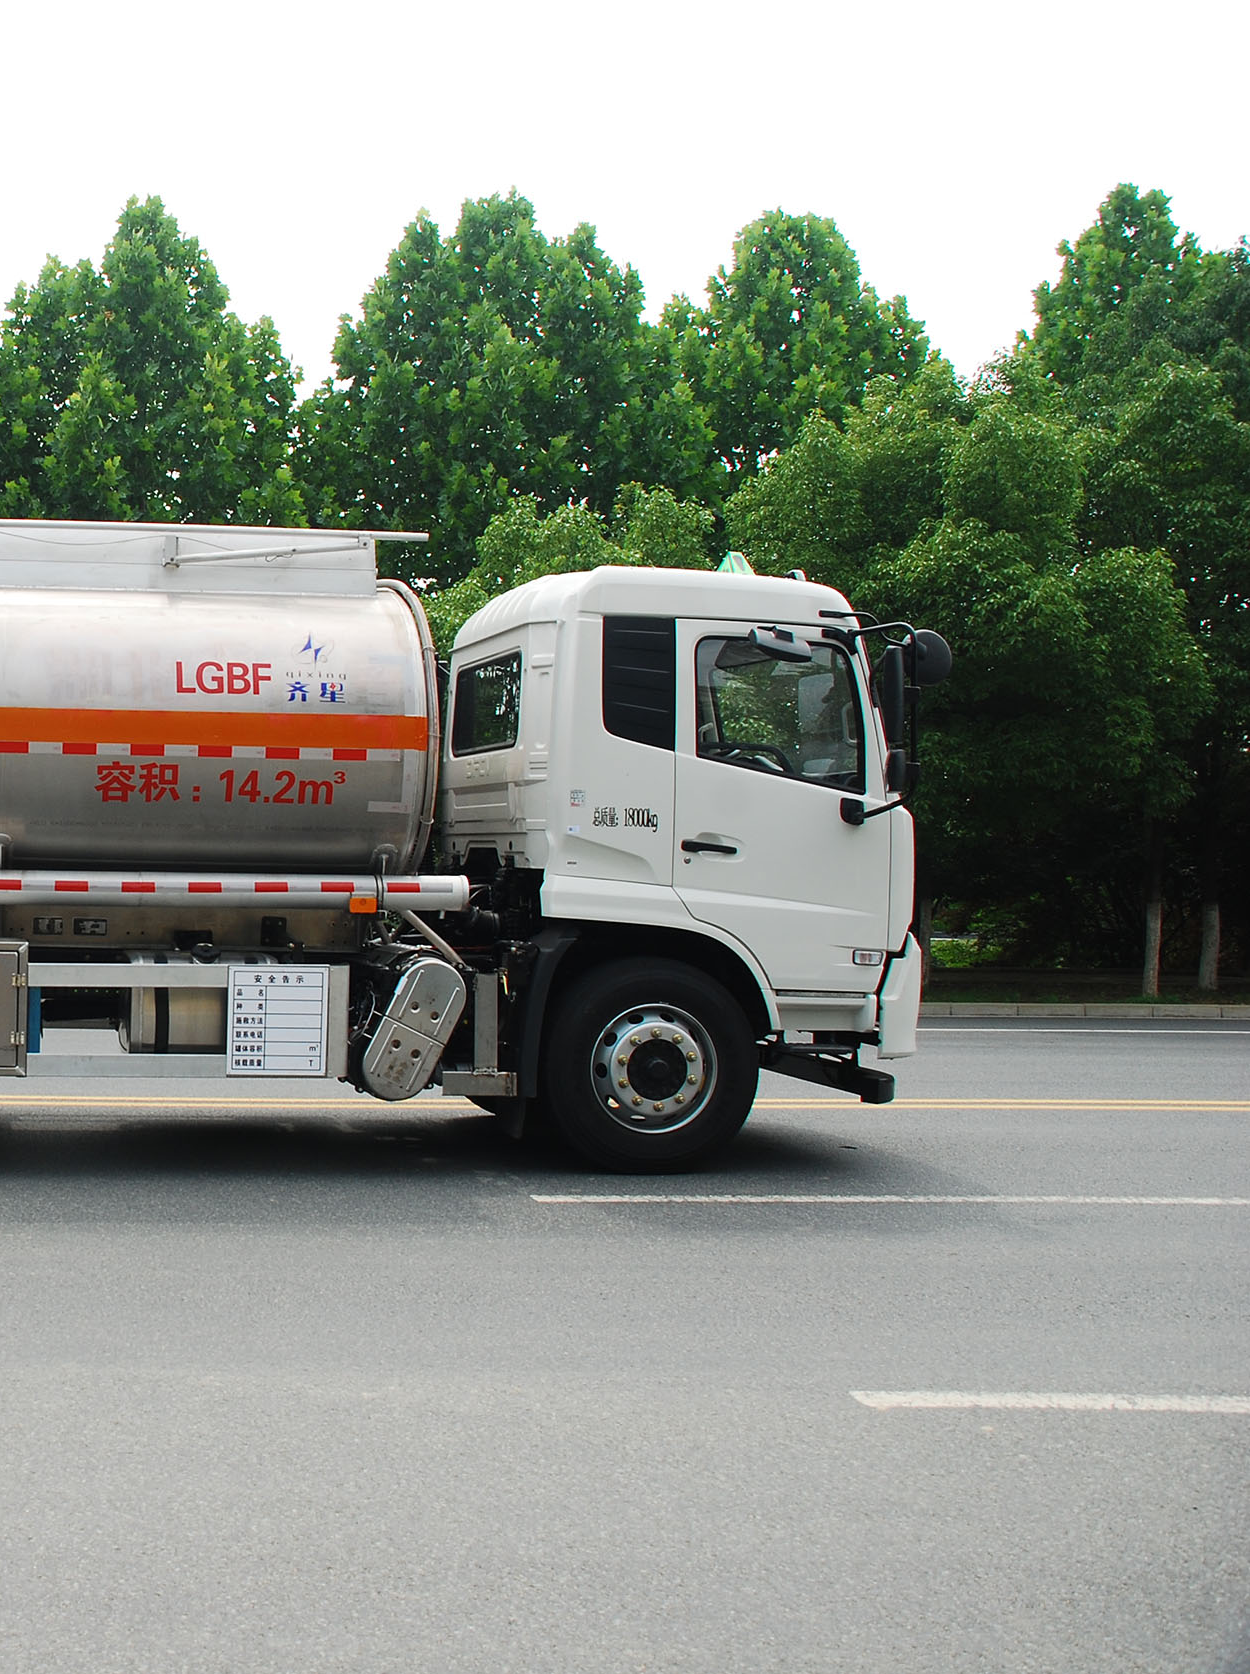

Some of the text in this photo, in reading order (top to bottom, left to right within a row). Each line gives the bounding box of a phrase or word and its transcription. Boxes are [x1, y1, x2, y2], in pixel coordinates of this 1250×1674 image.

[175, 661, 272, 695] LGBF
[285, 671, 347, 680] qixing
[286, 681, 346, 703] 齐星
[254, 974, 304, 984] 安全告示
